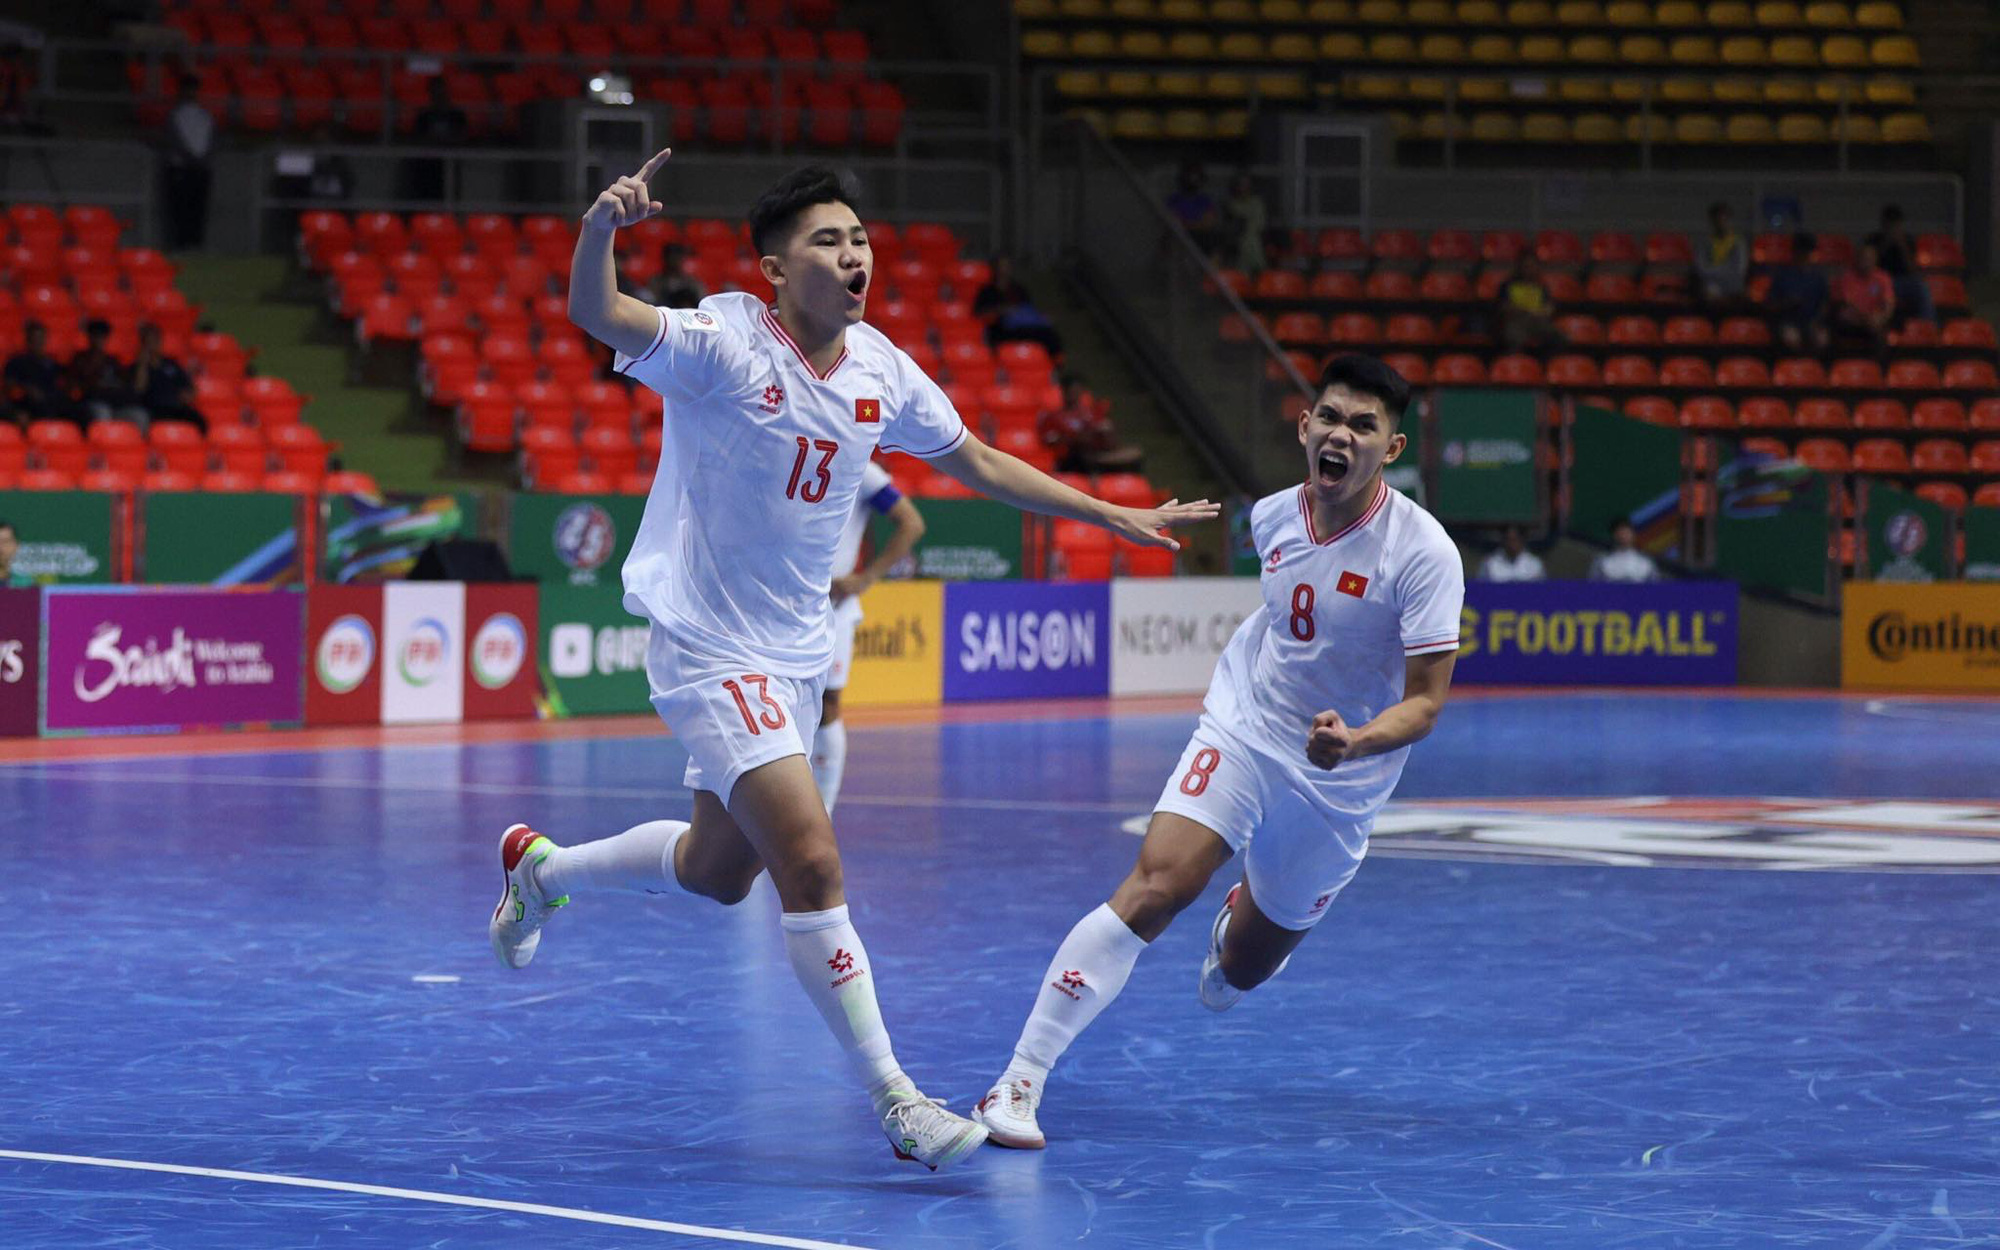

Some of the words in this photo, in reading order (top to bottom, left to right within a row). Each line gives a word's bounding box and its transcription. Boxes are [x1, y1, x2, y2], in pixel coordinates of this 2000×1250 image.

[786, 436, 839, 504] 13
[960, 609, 1096, 673] SAISON
[1290, 583, 1316, 641] 8
[721, 673, 786, 735] 13
[1180, 745, 1221, 797] 8
